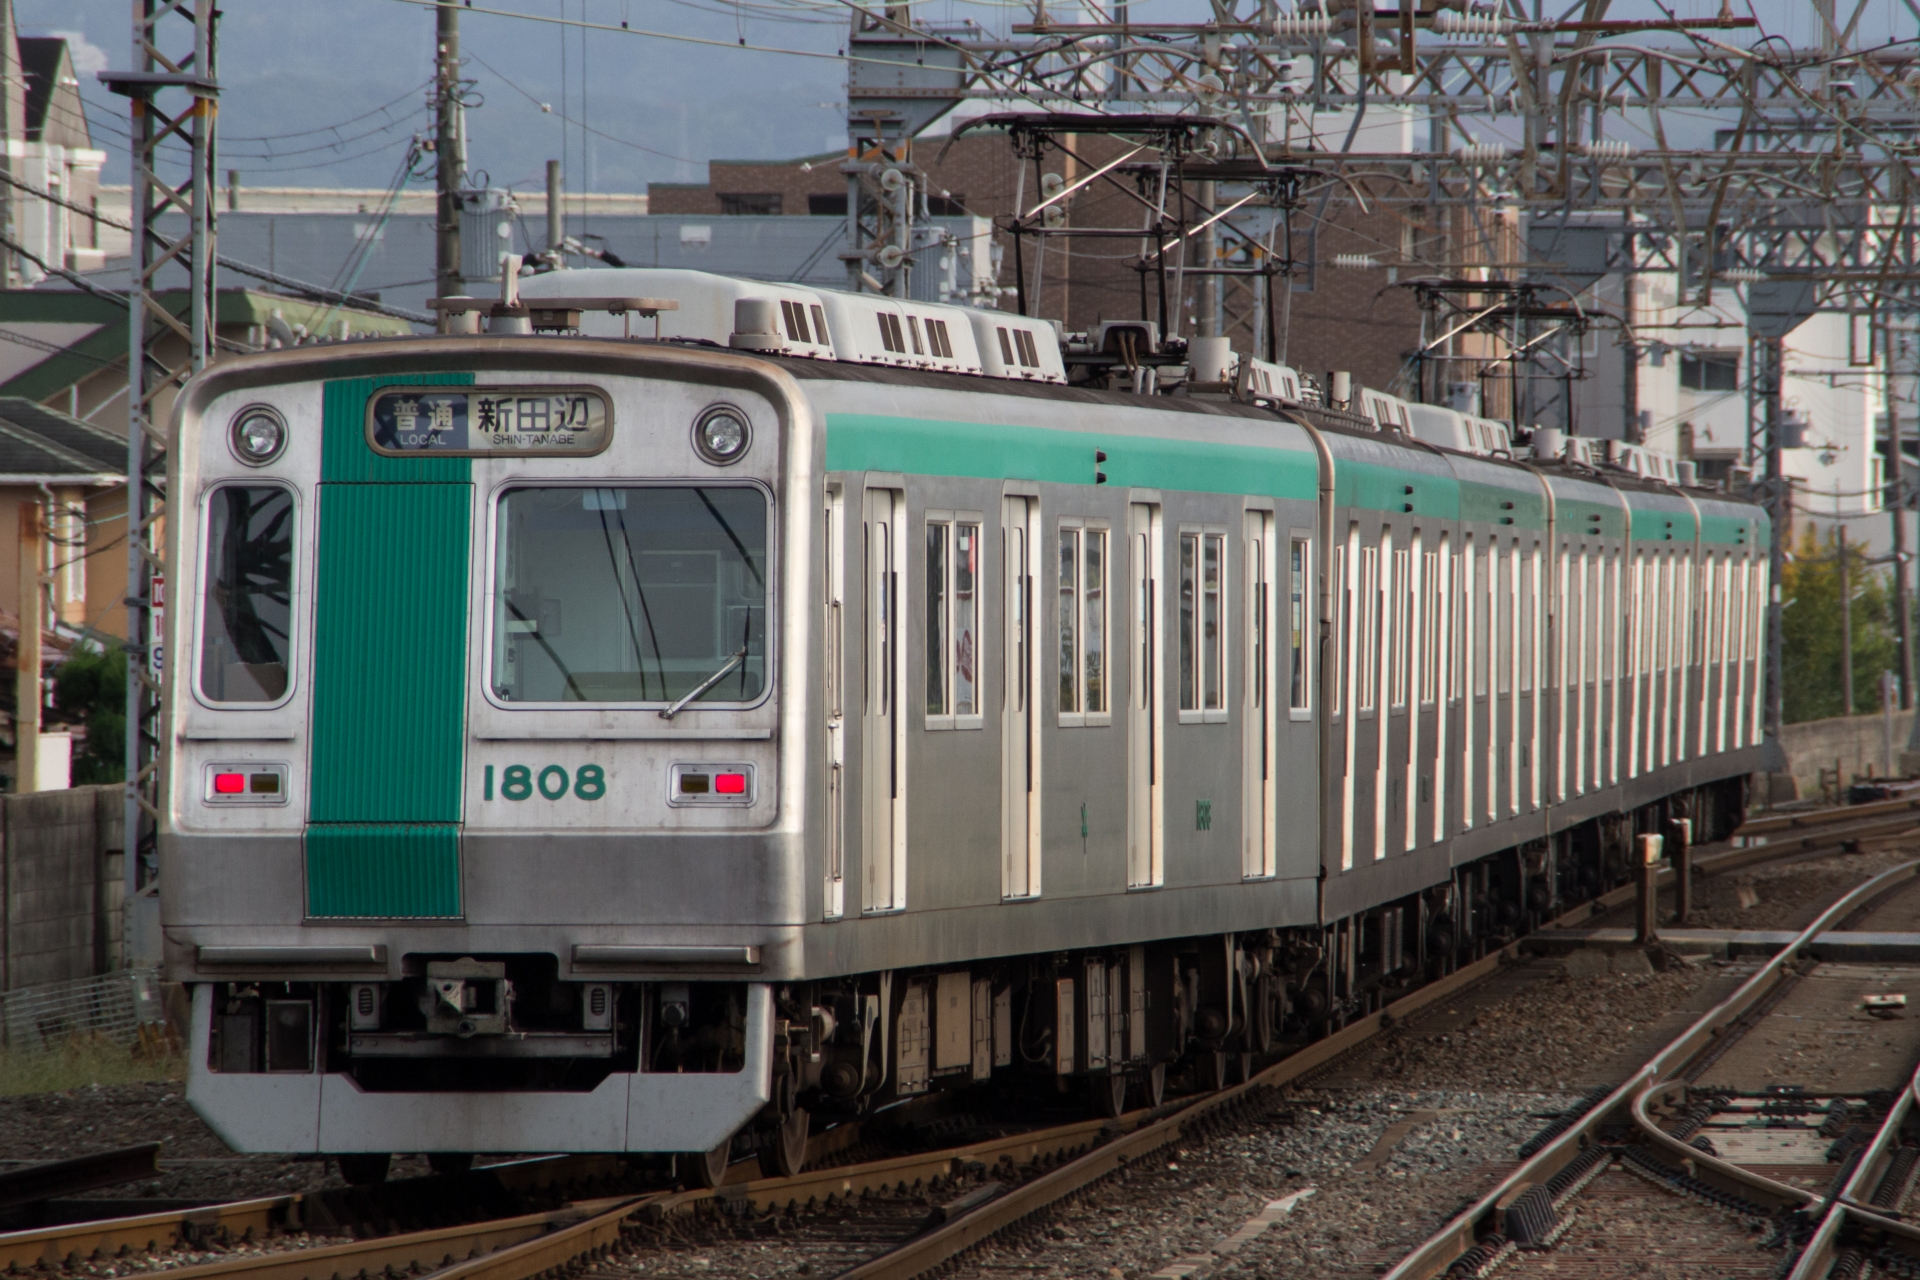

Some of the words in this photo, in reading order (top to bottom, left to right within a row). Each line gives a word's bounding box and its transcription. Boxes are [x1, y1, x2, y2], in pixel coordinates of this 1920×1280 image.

[393, 399, 454, 431] 普通
[478, 397, 590, 433] 新田辺
[401, 434, 447, 446] LOCAL
[493, 434, 575, 445] SHIN-TANABE
[484, 764, 606, 801] 1808
